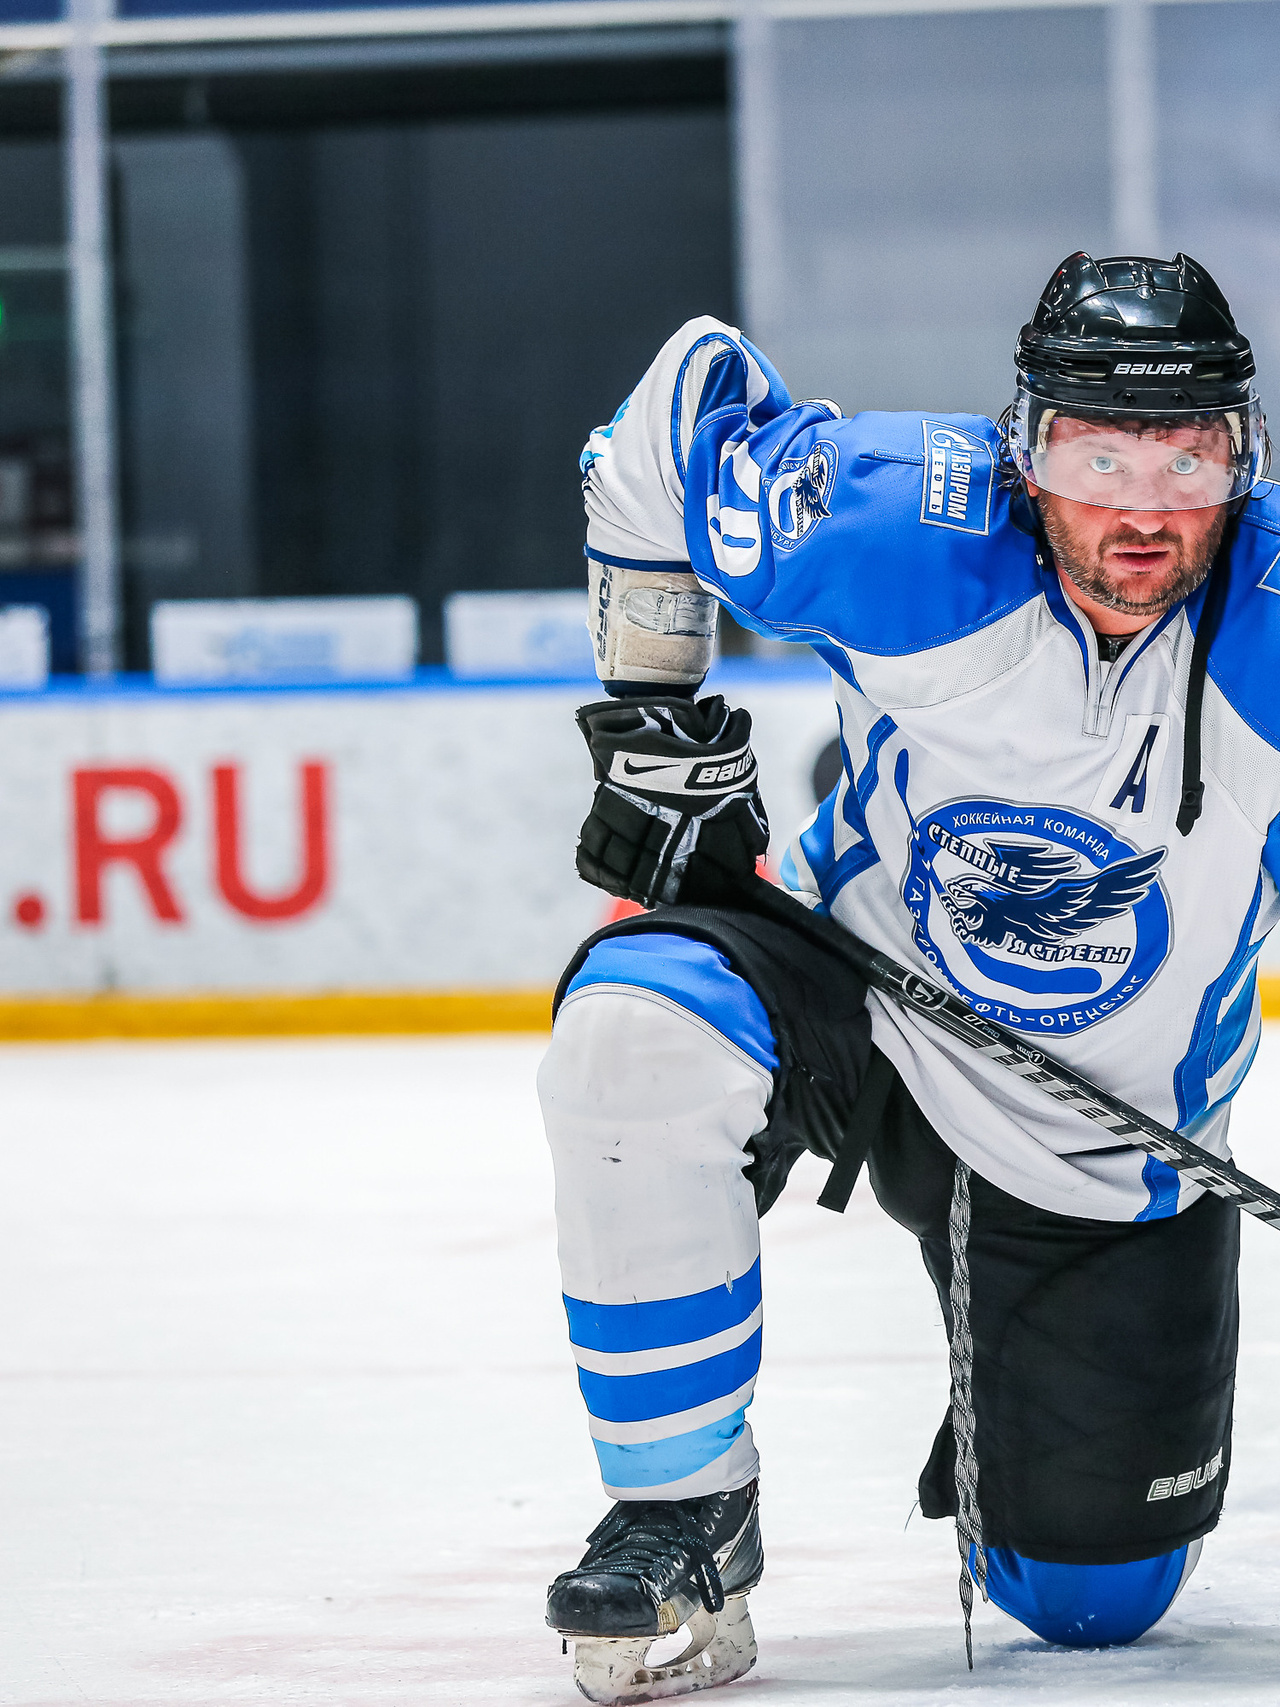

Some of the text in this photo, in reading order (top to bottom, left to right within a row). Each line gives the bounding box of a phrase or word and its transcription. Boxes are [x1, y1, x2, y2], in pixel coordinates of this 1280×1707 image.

[1113, 362, 1193, 375] BAUER
[946, 450, 972, 520] ГАЗПРОМ
[1109, 725, 1160, 813] A
[928, 824, 1022, 884] СТЕПНЫЕ
[952, 812, 1111, 861] ХОККЕЙНАЯ КОМАНДА
[1146, 1446, 1223, 1502] BAUE
